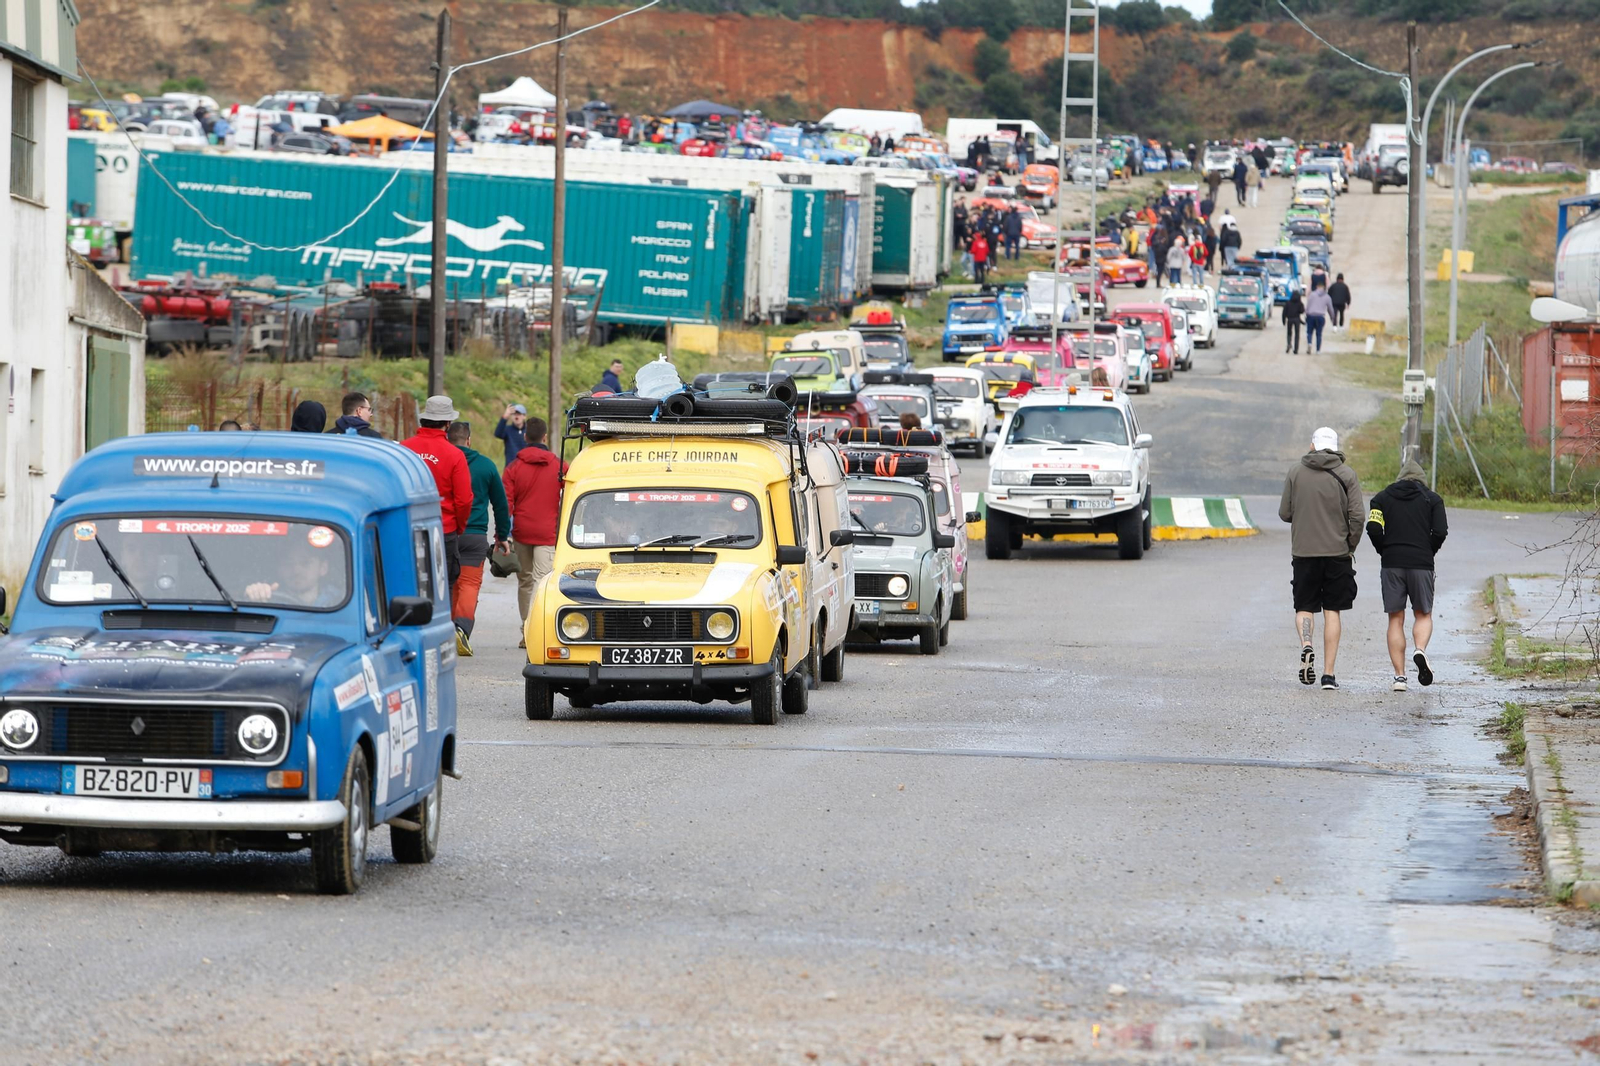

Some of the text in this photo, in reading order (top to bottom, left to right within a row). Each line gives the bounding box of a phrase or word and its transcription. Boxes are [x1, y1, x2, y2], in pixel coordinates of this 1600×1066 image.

[176, 181, 312, 200] www.marcotran.com
[656, 220, 693, 231] SPAIN
[631, 235, 692, 248] MOROCCO
[655, 253, 690, 264] ITALY
[638, 269, 690, 281] POLAND
[642, 286, 688, 298] RUSSIA
[612, 449, 738, 463] CAFÉ CHEZ JOURDAN
[143, 457, 317, 477] www.appart-s.fr
[155, 521, 171, 532] 4L
[175, 522, 223, 533] TROPHY
[225, 523, 250, 533] 2025
[611, 648, 683, 664] GZ-387-ZR
[83, 768, 193, 794] BZ-820-PV
[198, 784, 212, 797] 30
